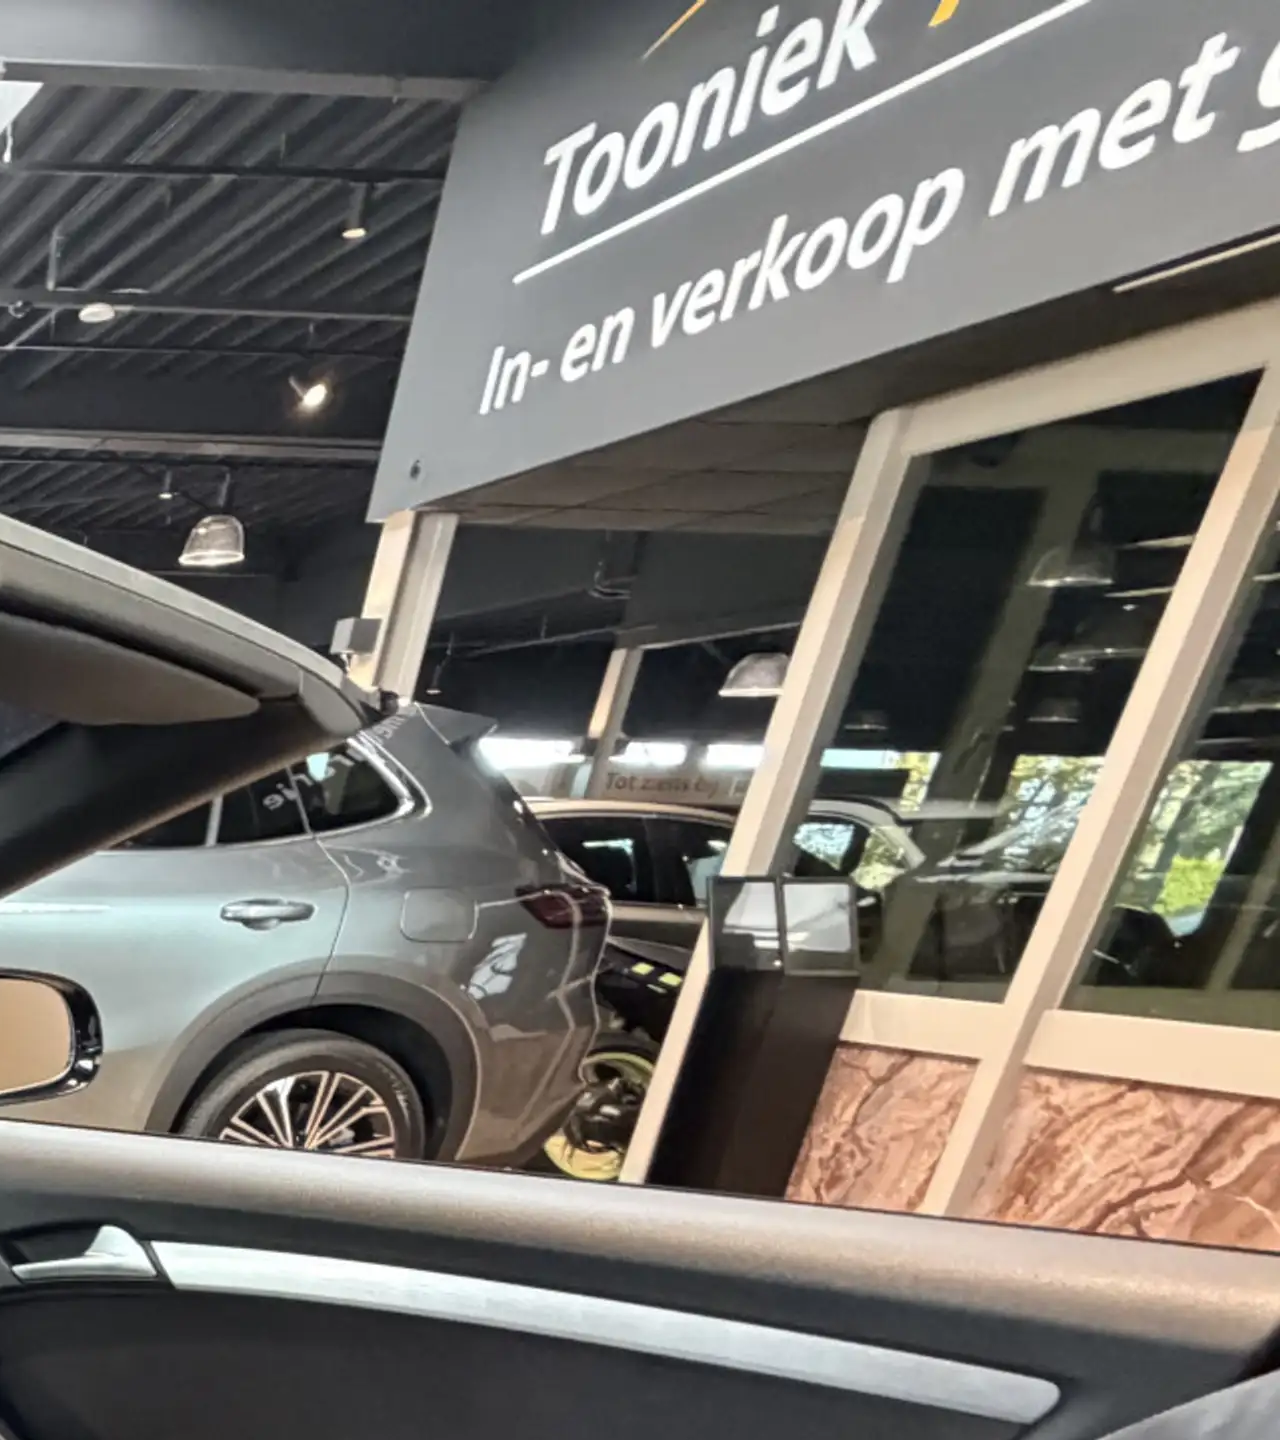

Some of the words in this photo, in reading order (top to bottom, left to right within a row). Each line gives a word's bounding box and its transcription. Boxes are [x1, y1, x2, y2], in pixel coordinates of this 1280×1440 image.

[479, 345, 550, 416] In-
[559, 306, 636, 383] en
[650, 168, 965, 349] verkoop
[987, 31, 1242, 218] met
[541, 0, 877, 236] Tooniek
